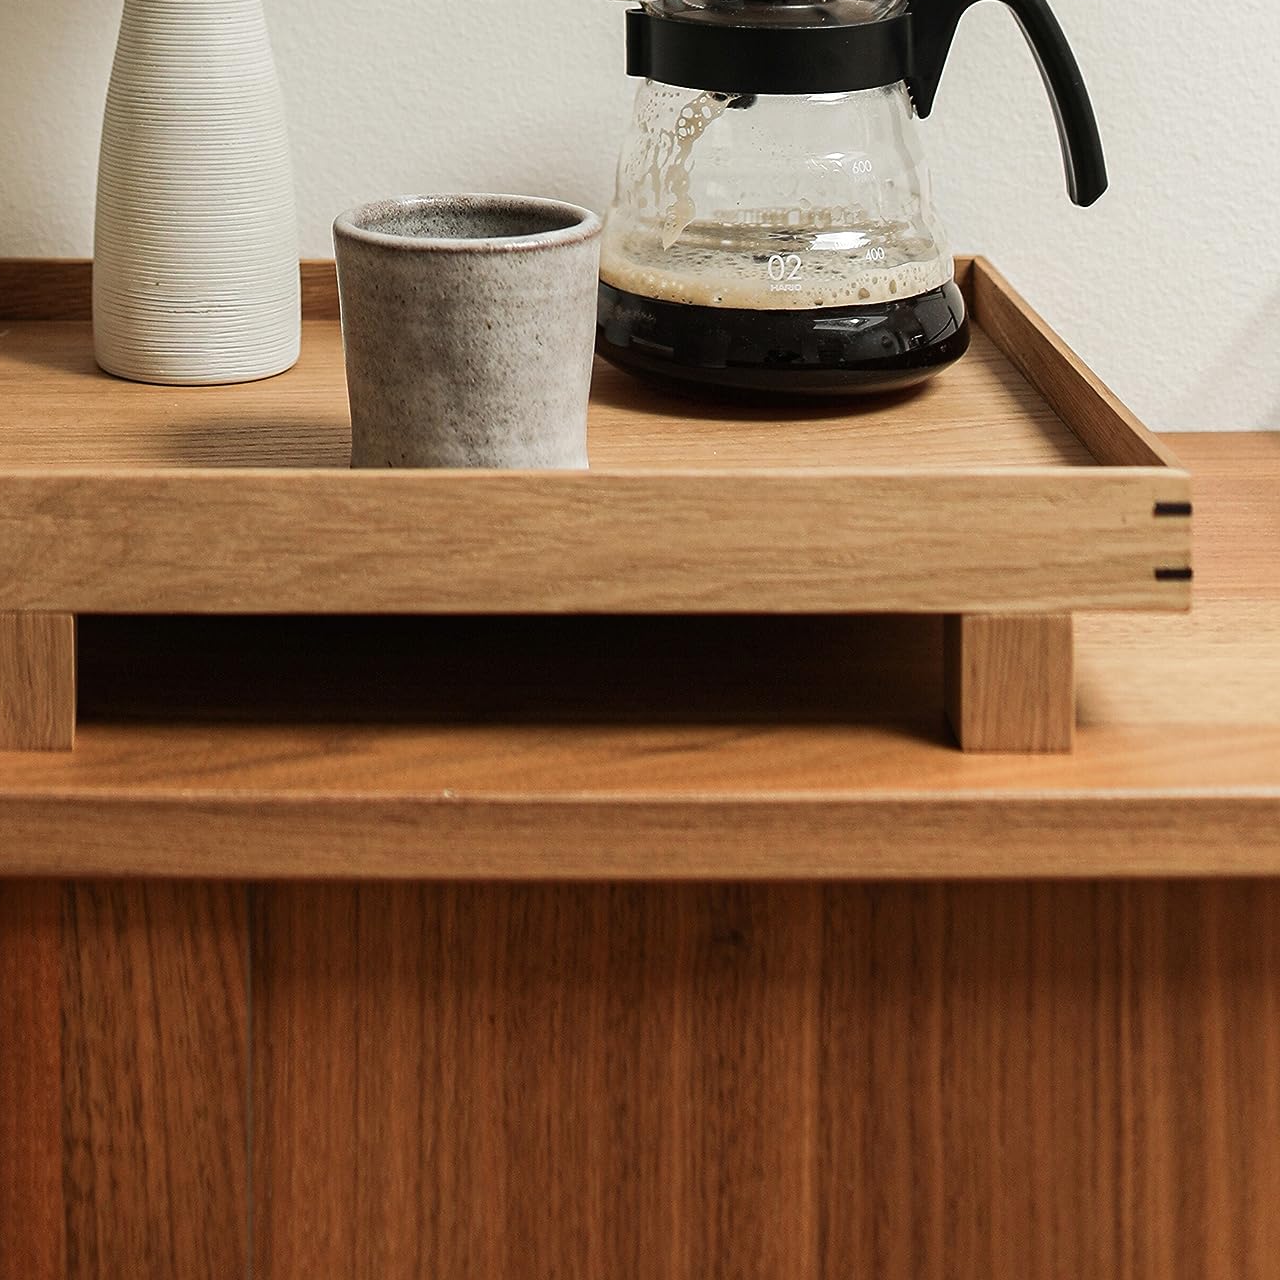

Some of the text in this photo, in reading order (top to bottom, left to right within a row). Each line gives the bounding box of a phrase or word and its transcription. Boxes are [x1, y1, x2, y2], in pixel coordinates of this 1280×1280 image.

[852, 159, 872, 173] 600
[865, 246, 885, 261] 400
[768, 254, 802, 281] 02
